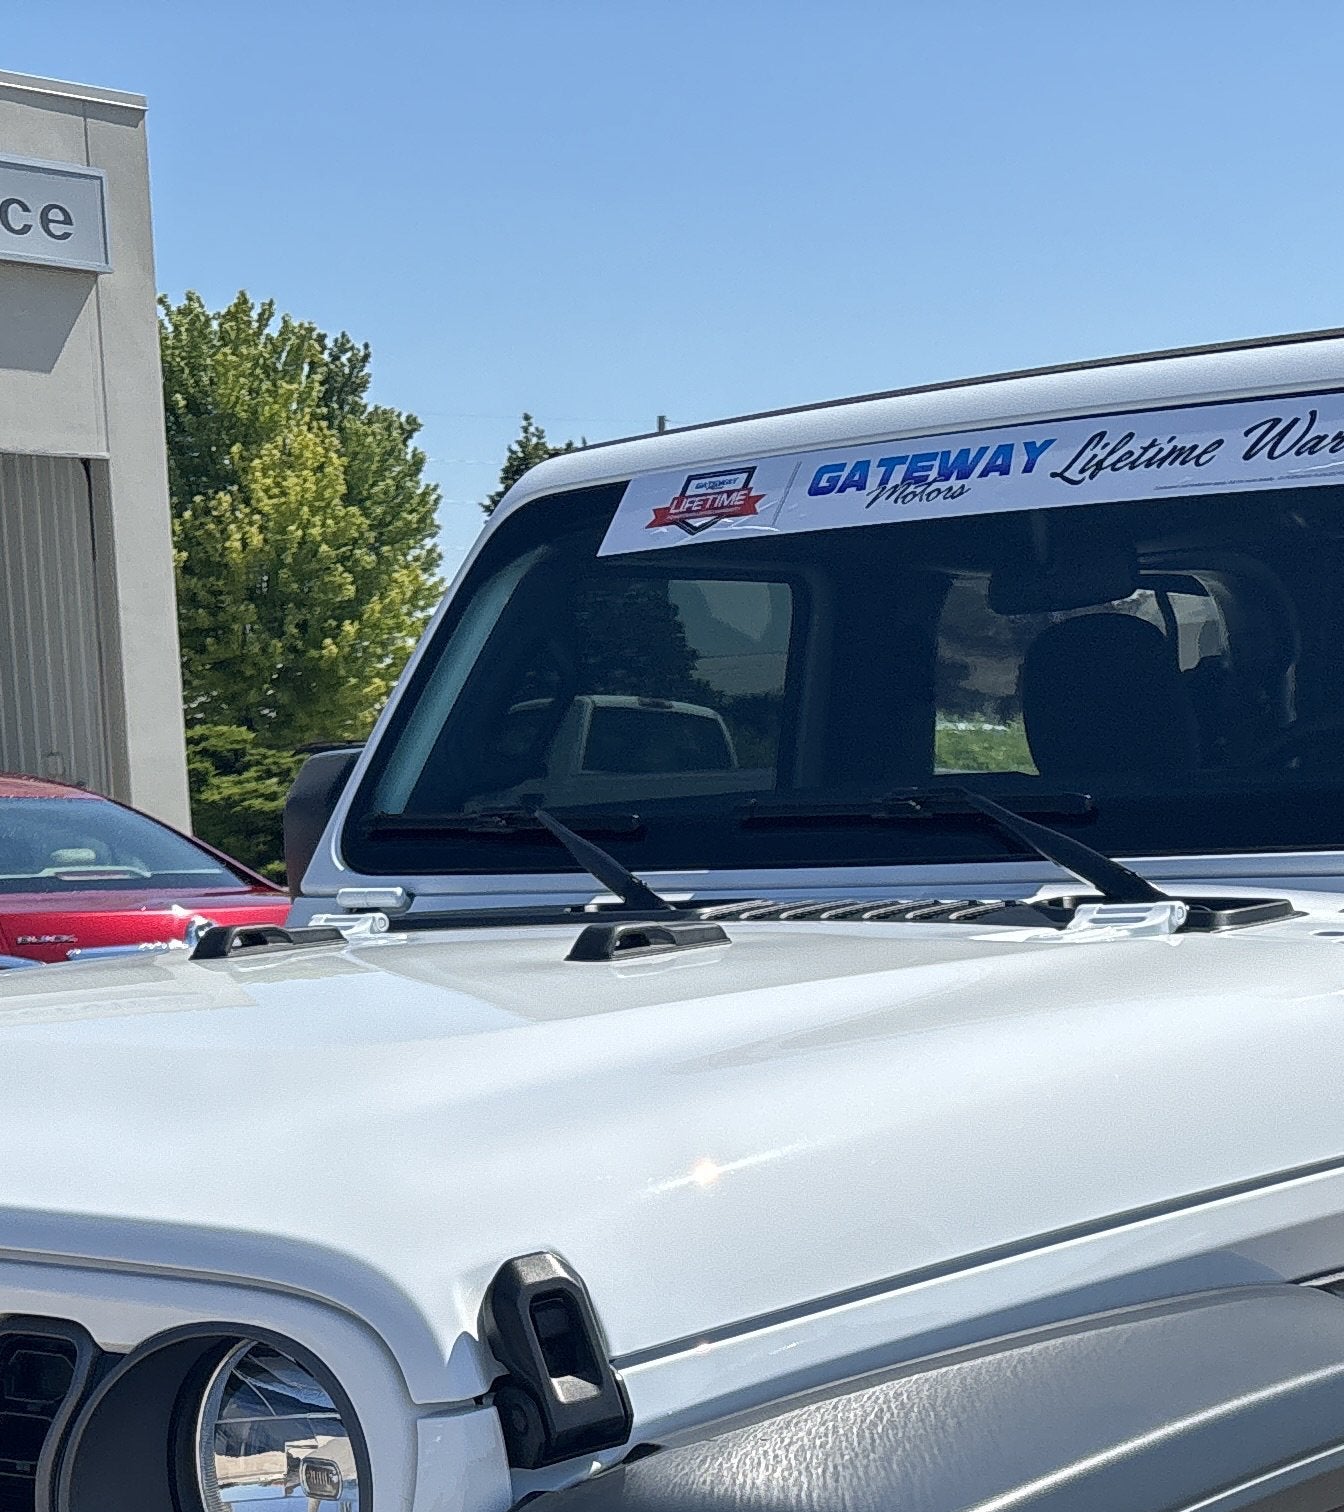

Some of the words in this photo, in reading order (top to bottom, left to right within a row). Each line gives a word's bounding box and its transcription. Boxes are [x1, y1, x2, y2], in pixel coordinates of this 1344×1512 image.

[807, 438, 1058, 497] GATEWAY
[1049, 430, 1224, 485] Lifetime
[669, 490, 749, 514] LIFETIME
[865, 477, 972, 509] Motors
